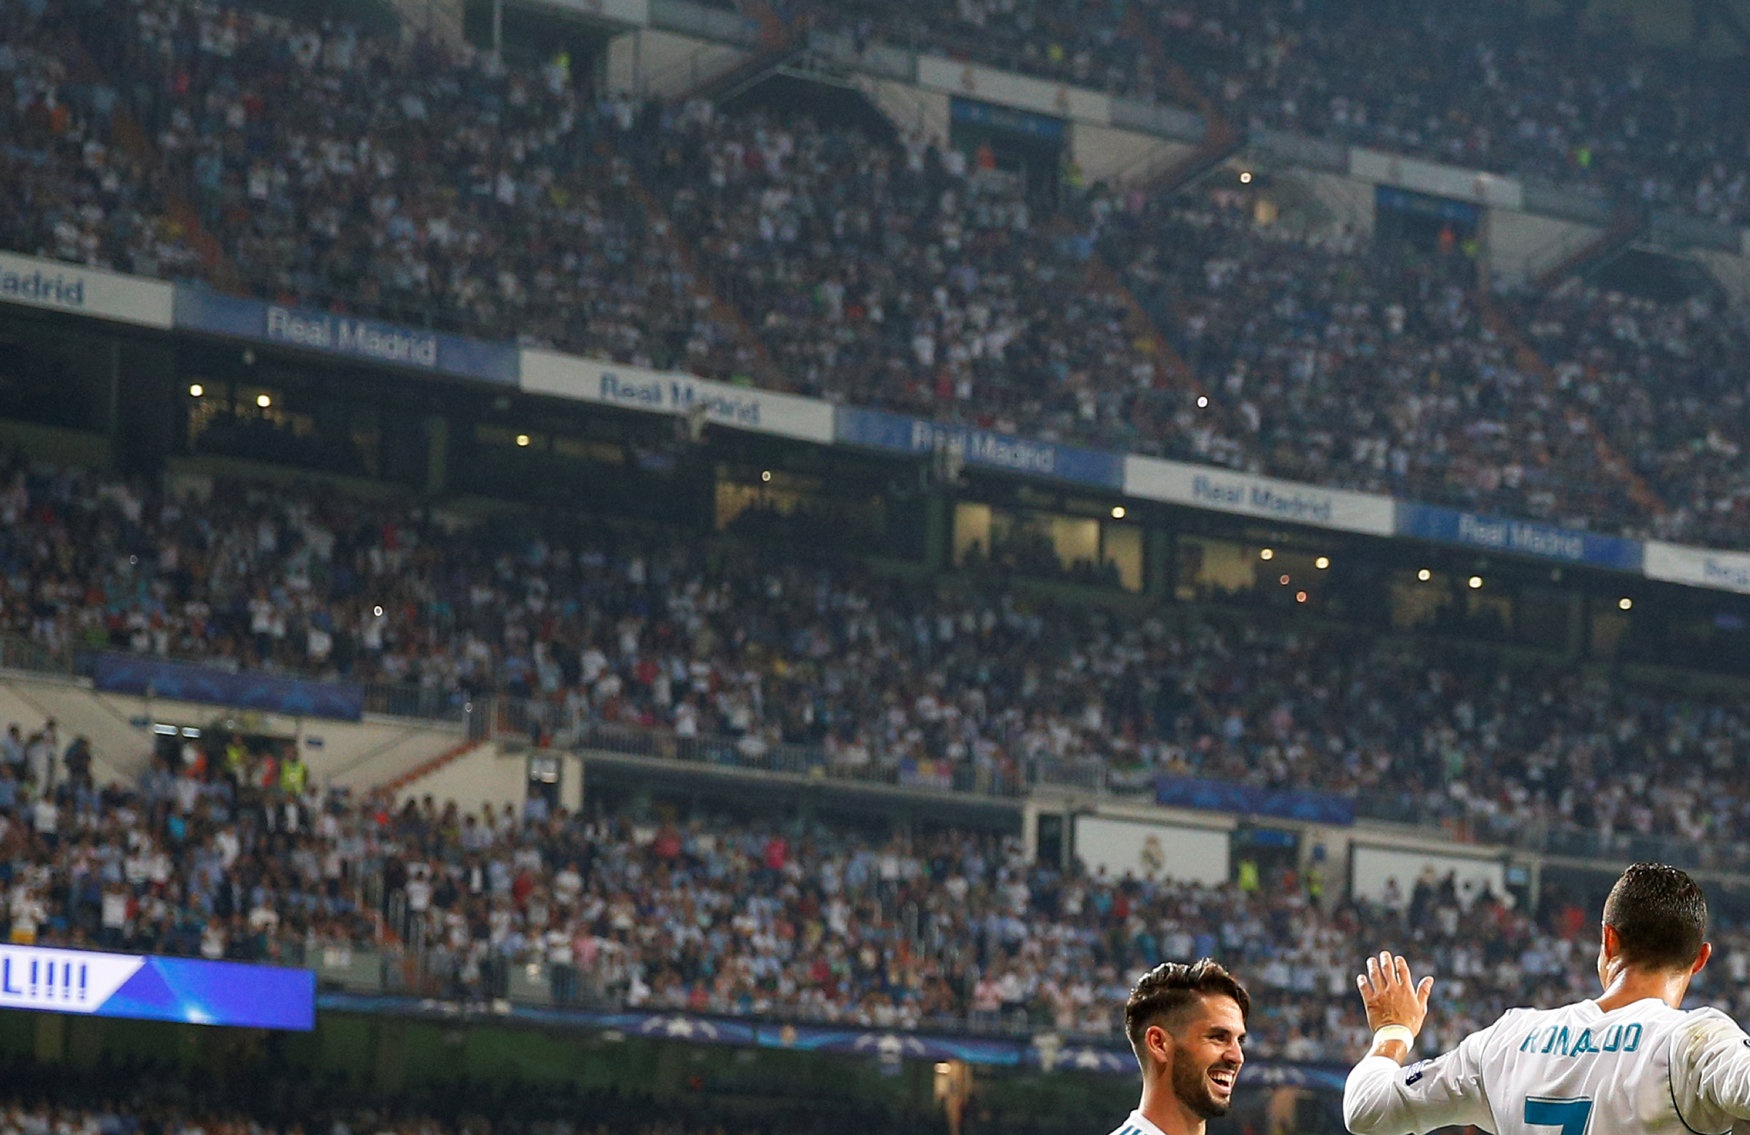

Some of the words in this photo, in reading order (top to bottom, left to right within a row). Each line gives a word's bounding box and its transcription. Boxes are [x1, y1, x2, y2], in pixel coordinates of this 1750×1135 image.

[0, 267, 85, 306] adrid
[267, 306, 331, 348] Real
[338, 319, 437, 367] Madrid
[600, 371, 661, 402] Real
[971, 430, 1057, 473] Madrid
[1192, 474, 1245, 502] Real
[1251, 486, 1332, 521] Madrid
[1458, 512, 1506, 544] Real
[1509, 523, 1583, 559] Madrid
[3, 956, 87, 1000] L!!!!
